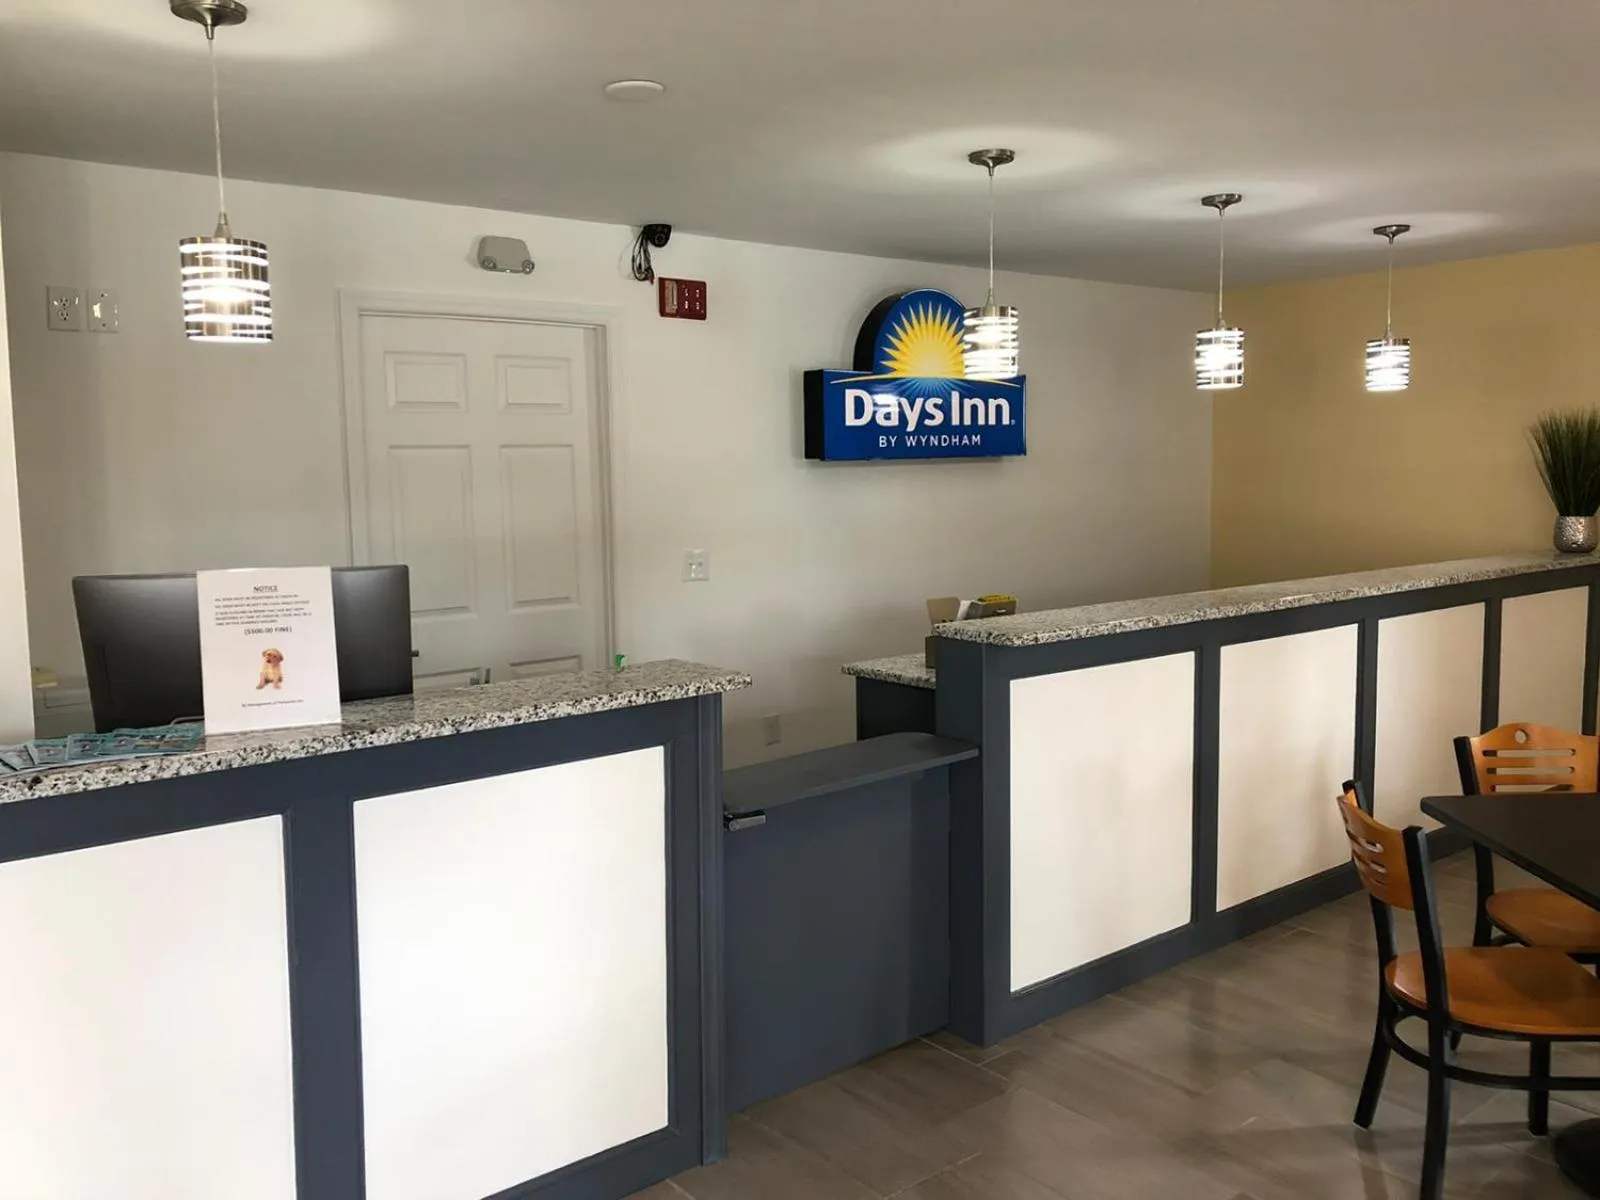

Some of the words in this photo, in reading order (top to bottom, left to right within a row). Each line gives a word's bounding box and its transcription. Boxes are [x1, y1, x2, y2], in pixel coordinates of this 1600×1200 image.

[844, 388, 945, 432] Days
[878, 435, 898, 448] BY
[905, 434, 982, 448] WYNDHAM
